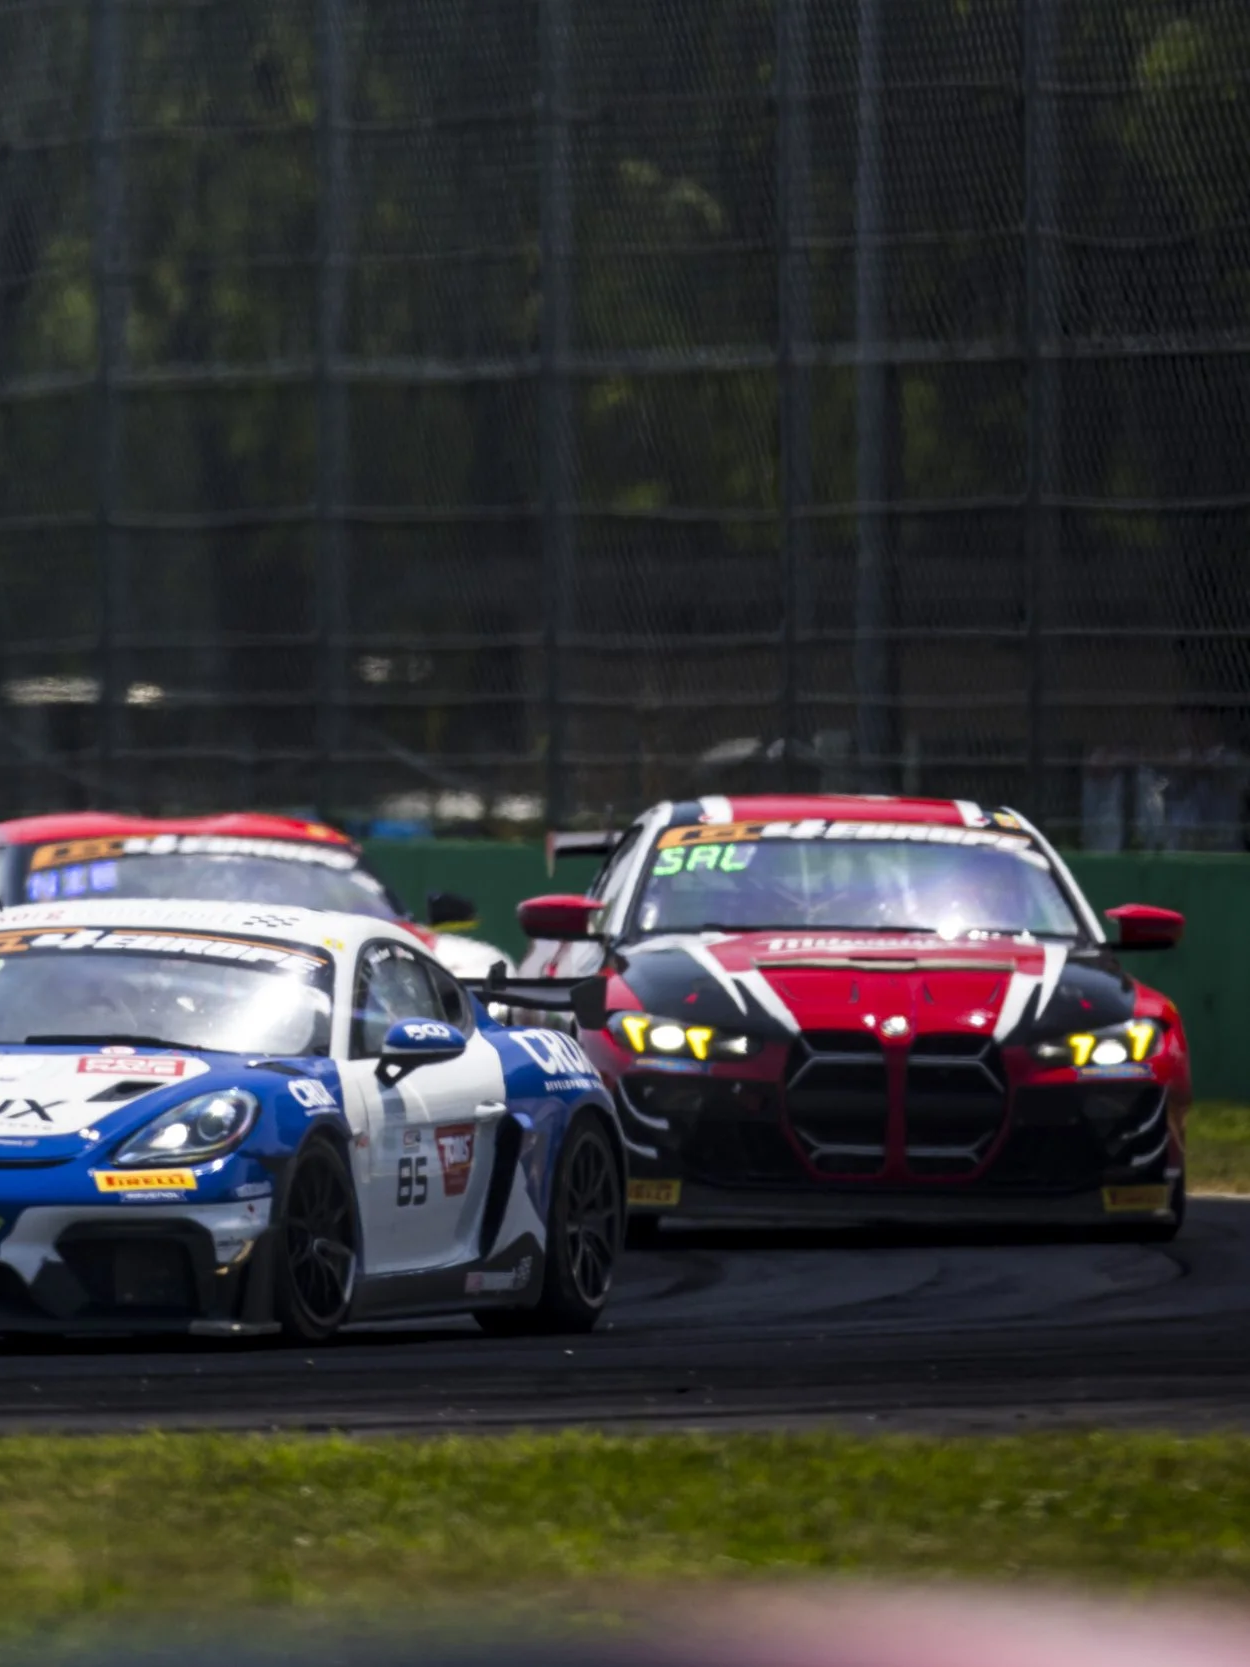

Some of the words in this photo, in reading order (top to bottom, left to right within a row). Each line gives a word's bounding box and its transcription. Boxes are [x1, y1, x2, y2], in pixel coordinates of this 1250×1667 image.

[826, 822, 1031, 851] EUROPE
[93, 931, 324, 974] EUROPE
[105, 1173, 186, 1187] PIRELLI
[396, 1156, 428, 1208] 85
